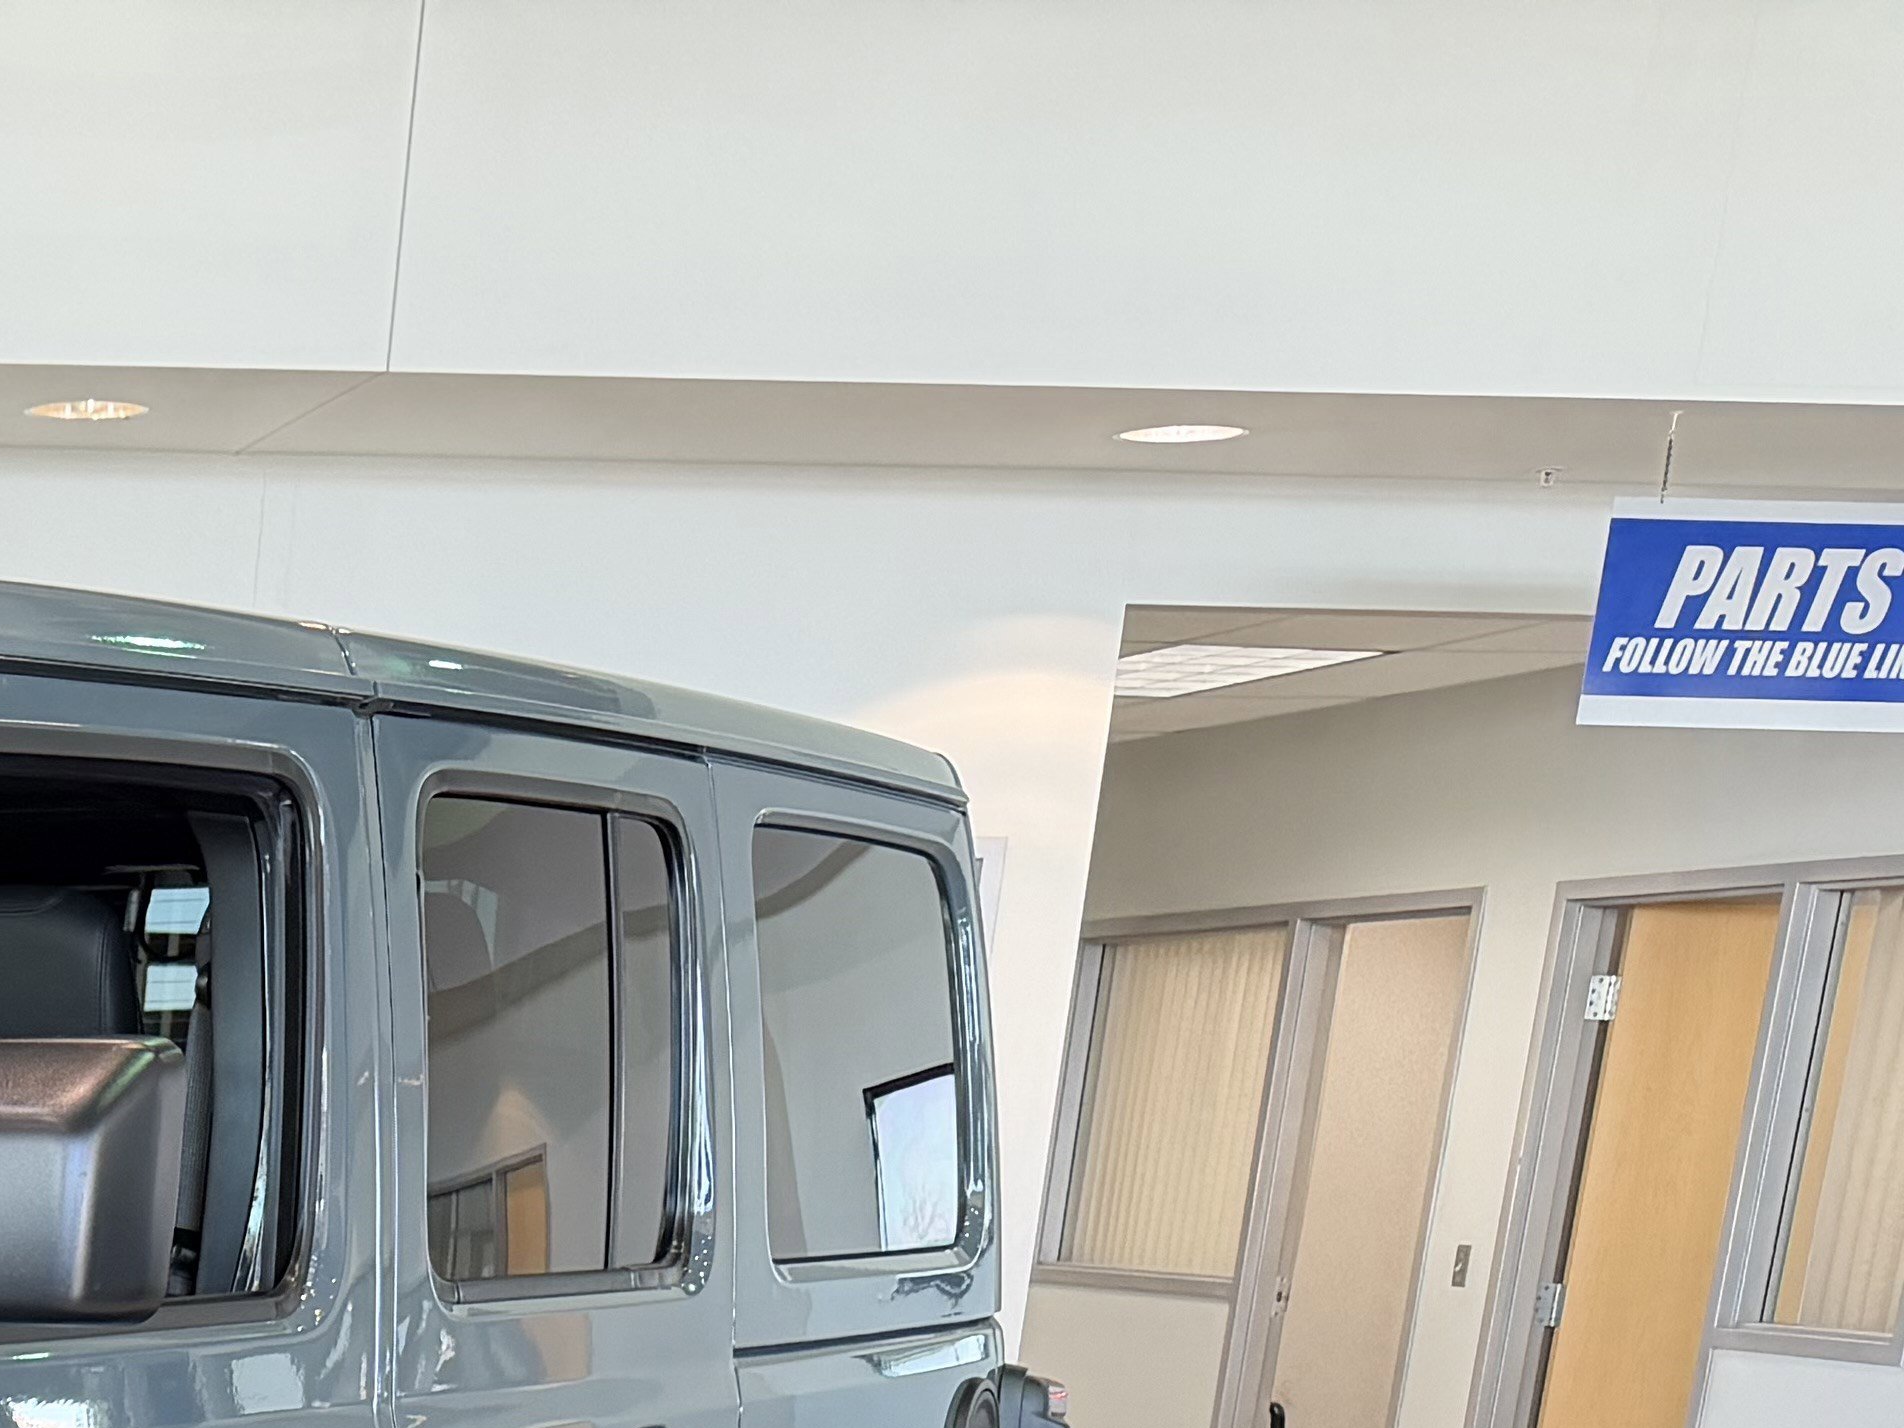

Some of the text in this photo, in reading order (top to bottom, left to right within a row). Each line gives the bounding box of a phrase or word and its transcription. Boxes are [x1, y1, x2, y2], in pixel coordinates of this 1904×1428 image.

[1653, 544, 1904, 635] PARTS
[1601, 636, 1729, 676] FOLLOW
[1726, 640, 1790, 677] THE
[1784, 641, 1868, 680] BLUE
